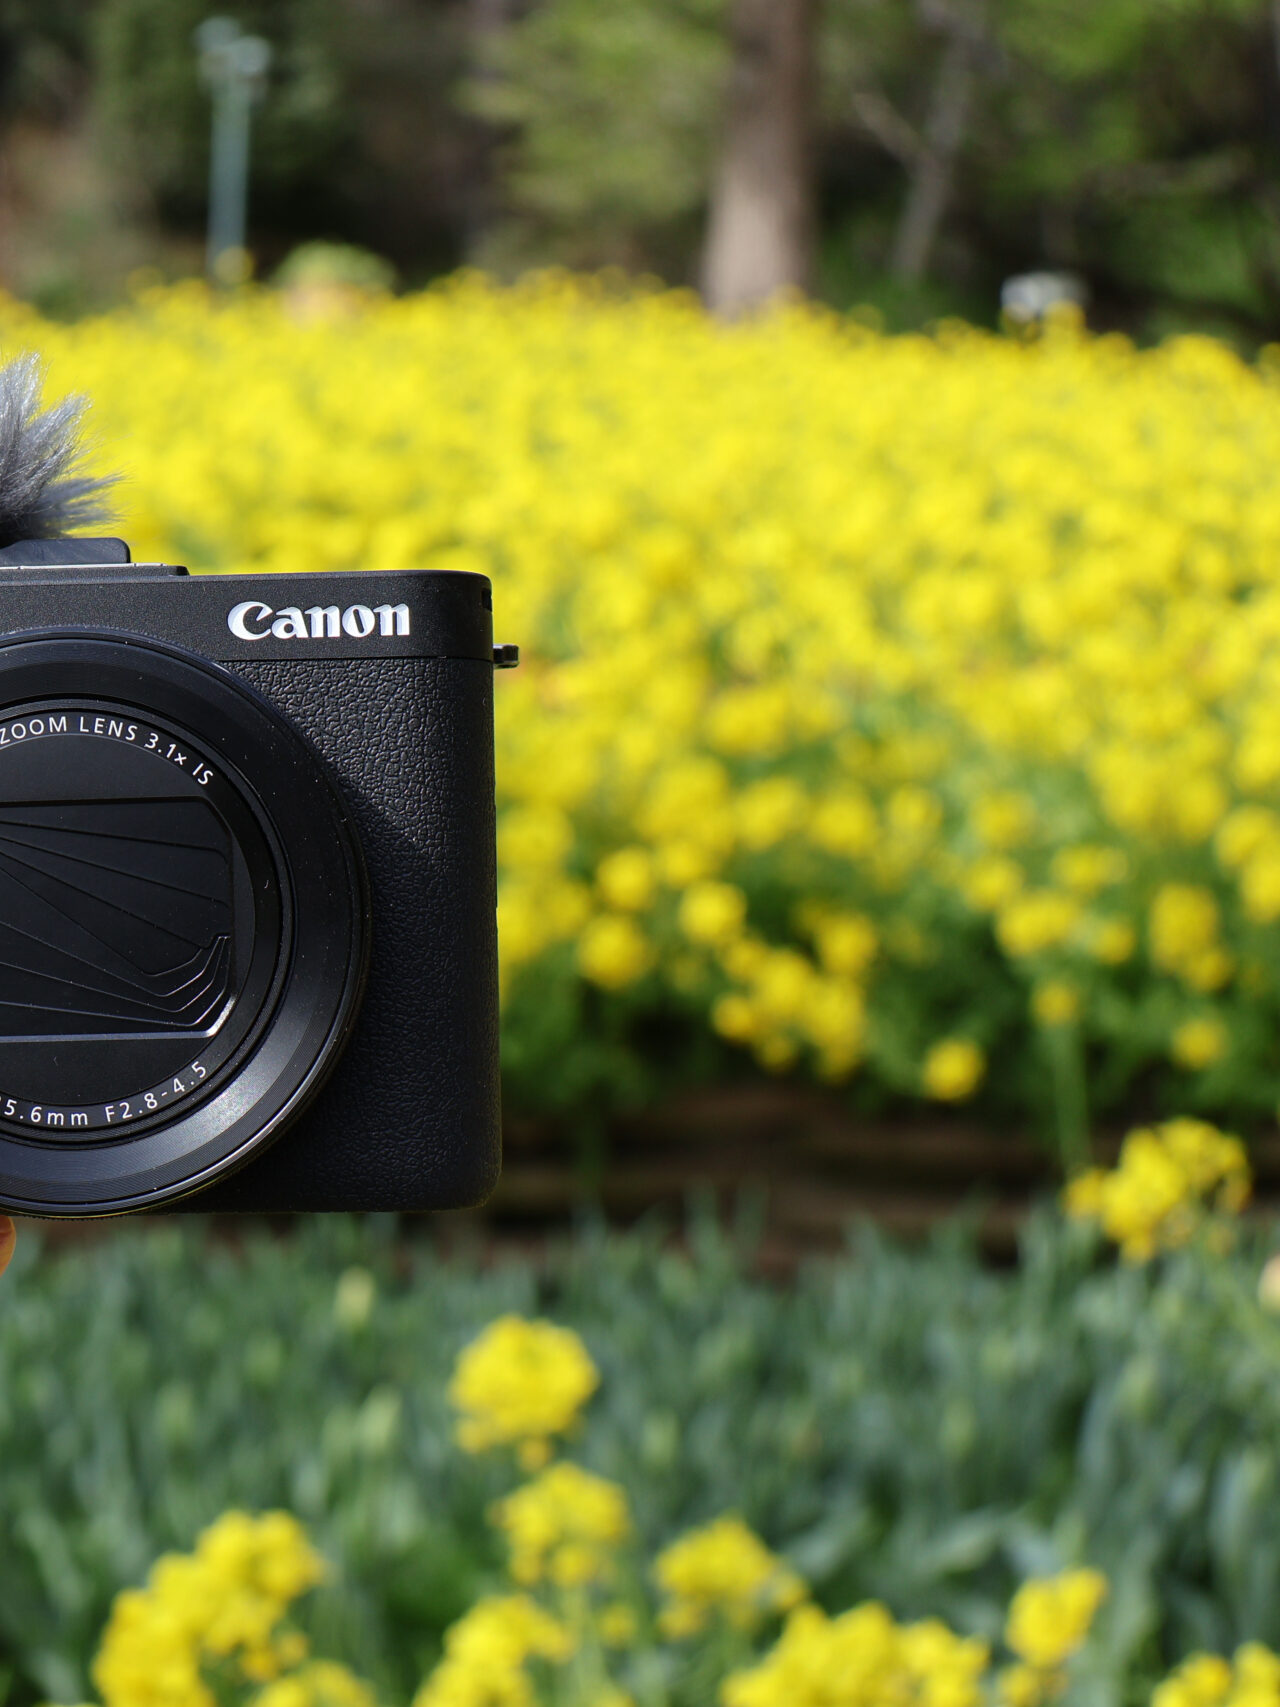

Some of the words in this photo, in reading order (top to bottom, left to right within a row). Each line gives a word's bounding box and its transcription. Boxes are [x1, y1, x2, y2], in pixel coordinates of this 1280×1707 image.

[227, 600, 411, 641] Canon
[79, 716, 138, 742] LENS
[192, 762, 214, 786] IS
[104, 1060, 207, 1123] F2.8-4.5
